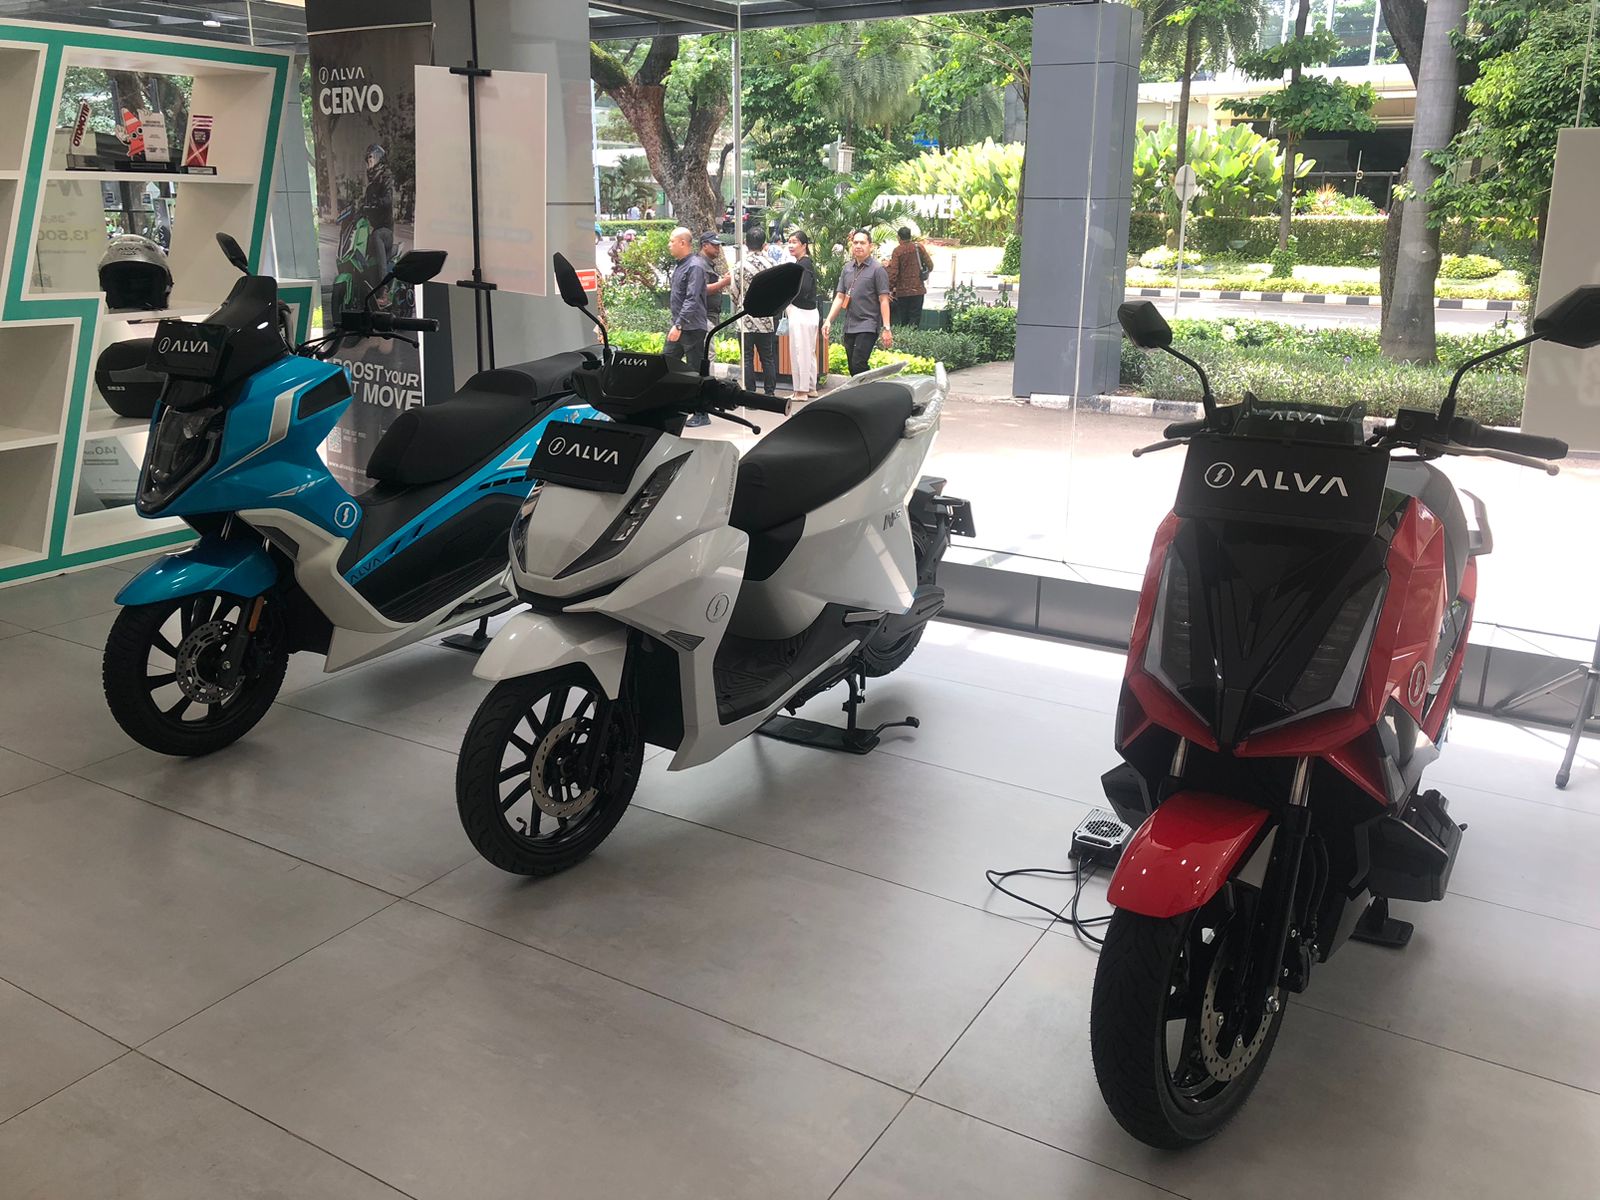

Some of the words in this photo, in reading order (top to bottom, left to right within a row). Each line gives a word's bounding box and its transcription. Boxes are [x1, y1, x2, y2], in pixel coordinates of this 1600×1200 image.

[331, 66, 365, 80] ALVA
[319, 84, 384, 115] CERVO
[73, 103, 90, 147] OTOMOTIF
[171, 340, 209, 353] ALVA
[619, 357, 648, 367] ALVA
[384, 369, 419, 387] YOUR
[363, 382, 422, 411] MOVE
[1269, 410, 1326, 425] ALVA
[566, 443, 620, 465] ALVA
[1240, 468, 1349, 497] ALVA
[350, 556, 382, 583] ALVA
